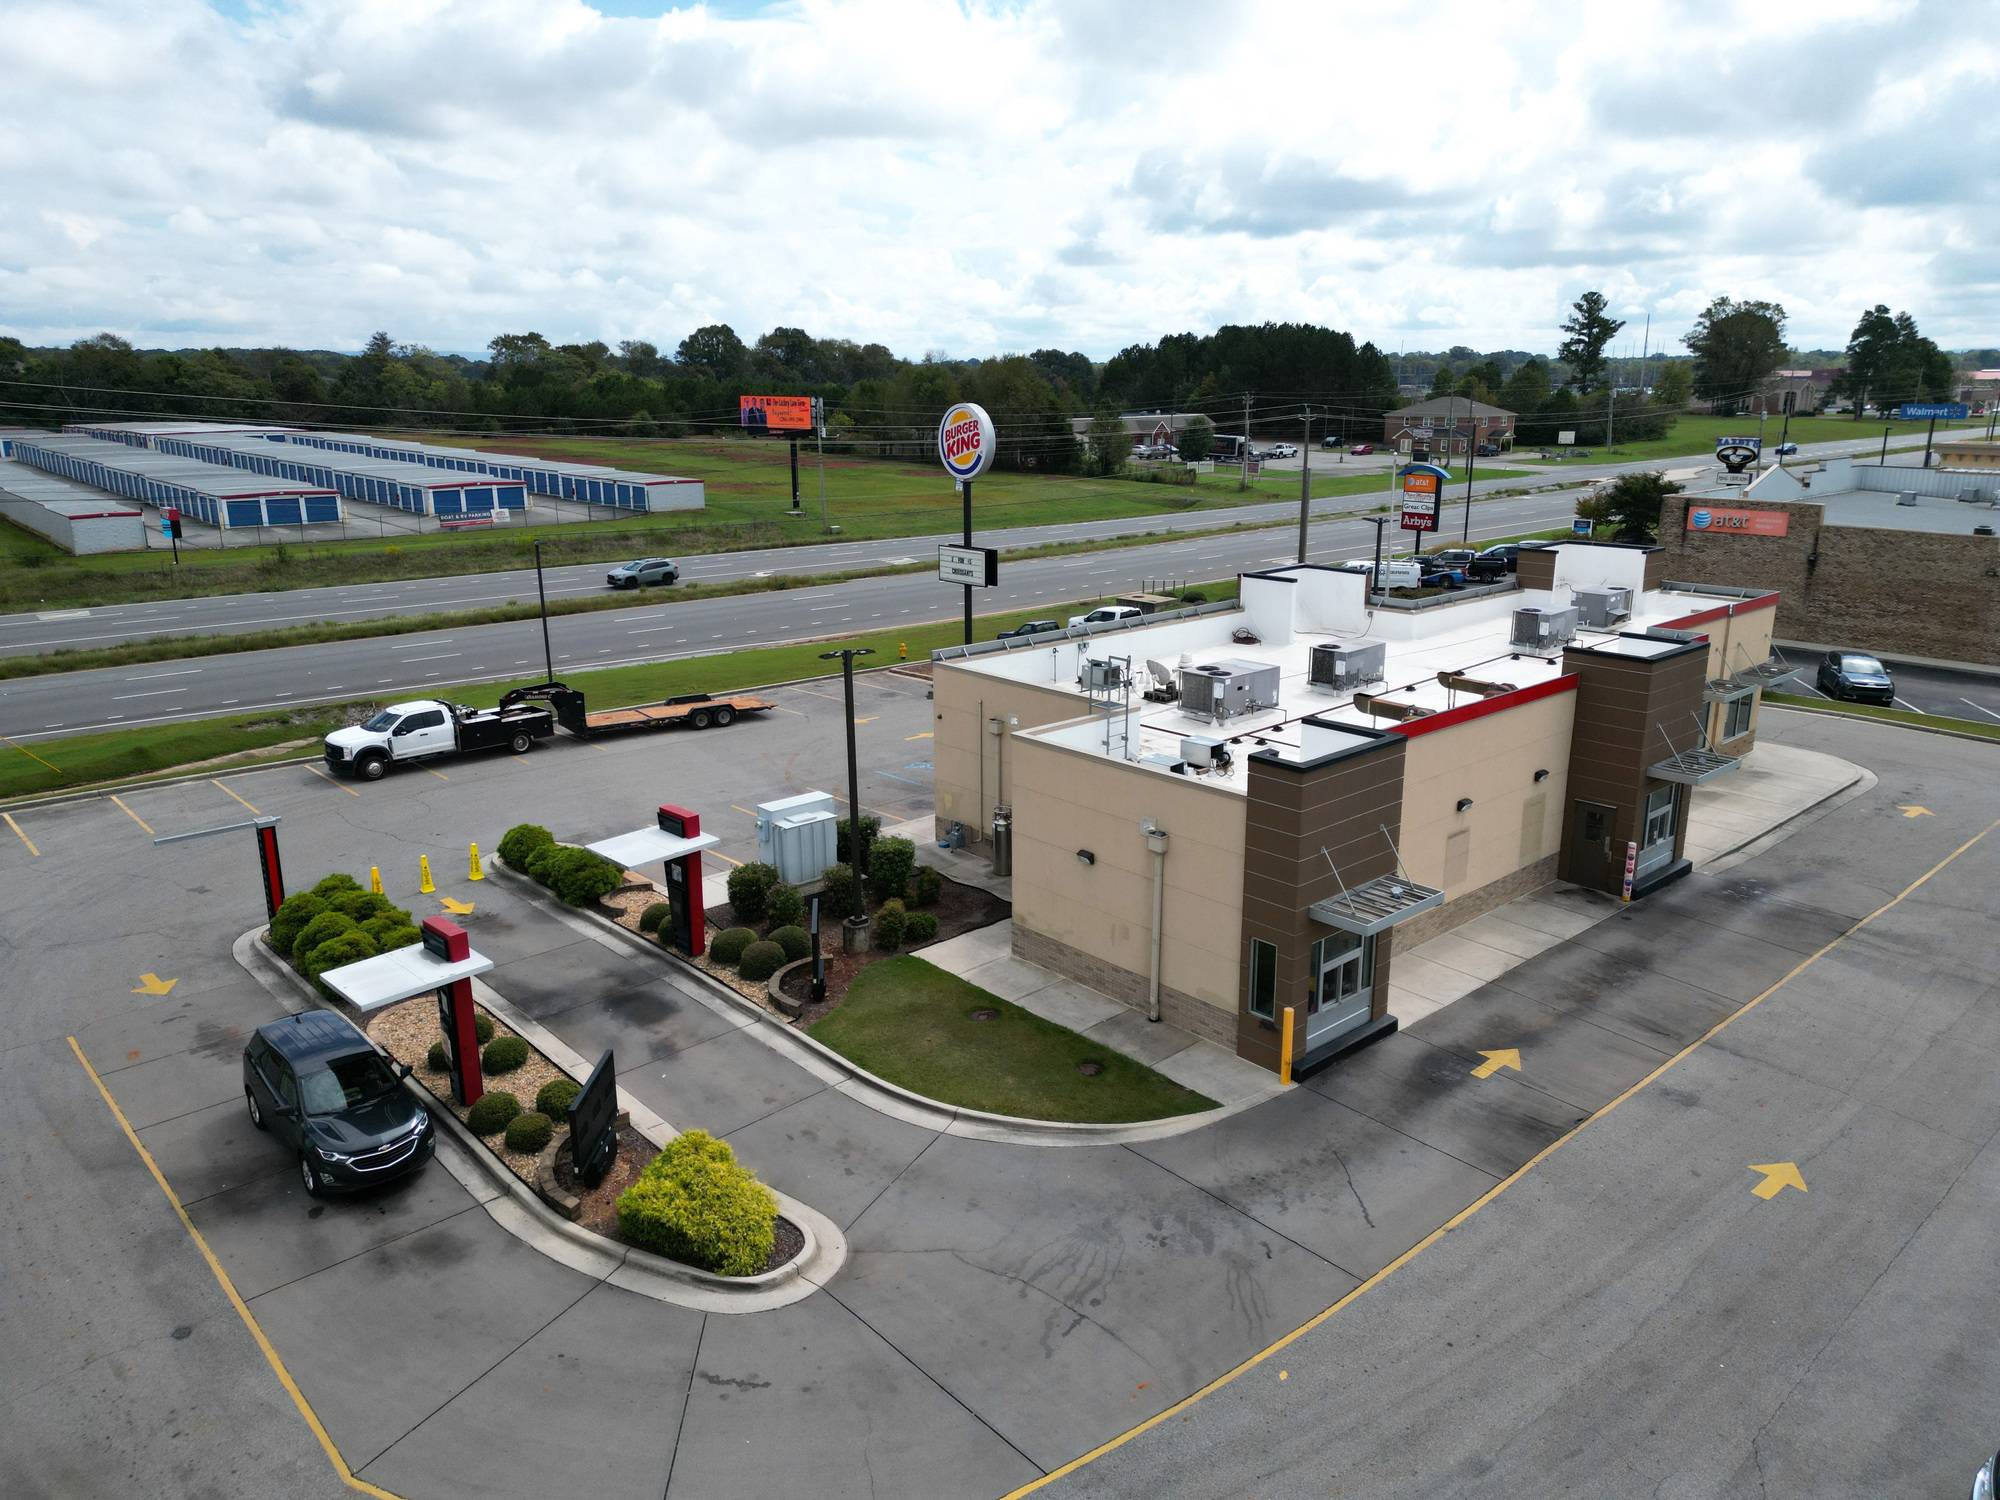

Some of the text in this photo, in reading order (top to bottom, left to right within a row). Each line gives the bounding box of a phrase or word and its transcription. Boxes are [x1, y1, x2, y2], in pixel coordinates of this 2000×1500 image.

[1906, 407, 1949, 417] Walmart
[945, 420, 979, 443] BURGER
[946, 431, 981, 459] KING
[1421, 504, 1434, 512] Clips
[1402, 515, 1432, 528] Arby's
[1714, 512, 1750, 528] at&t
